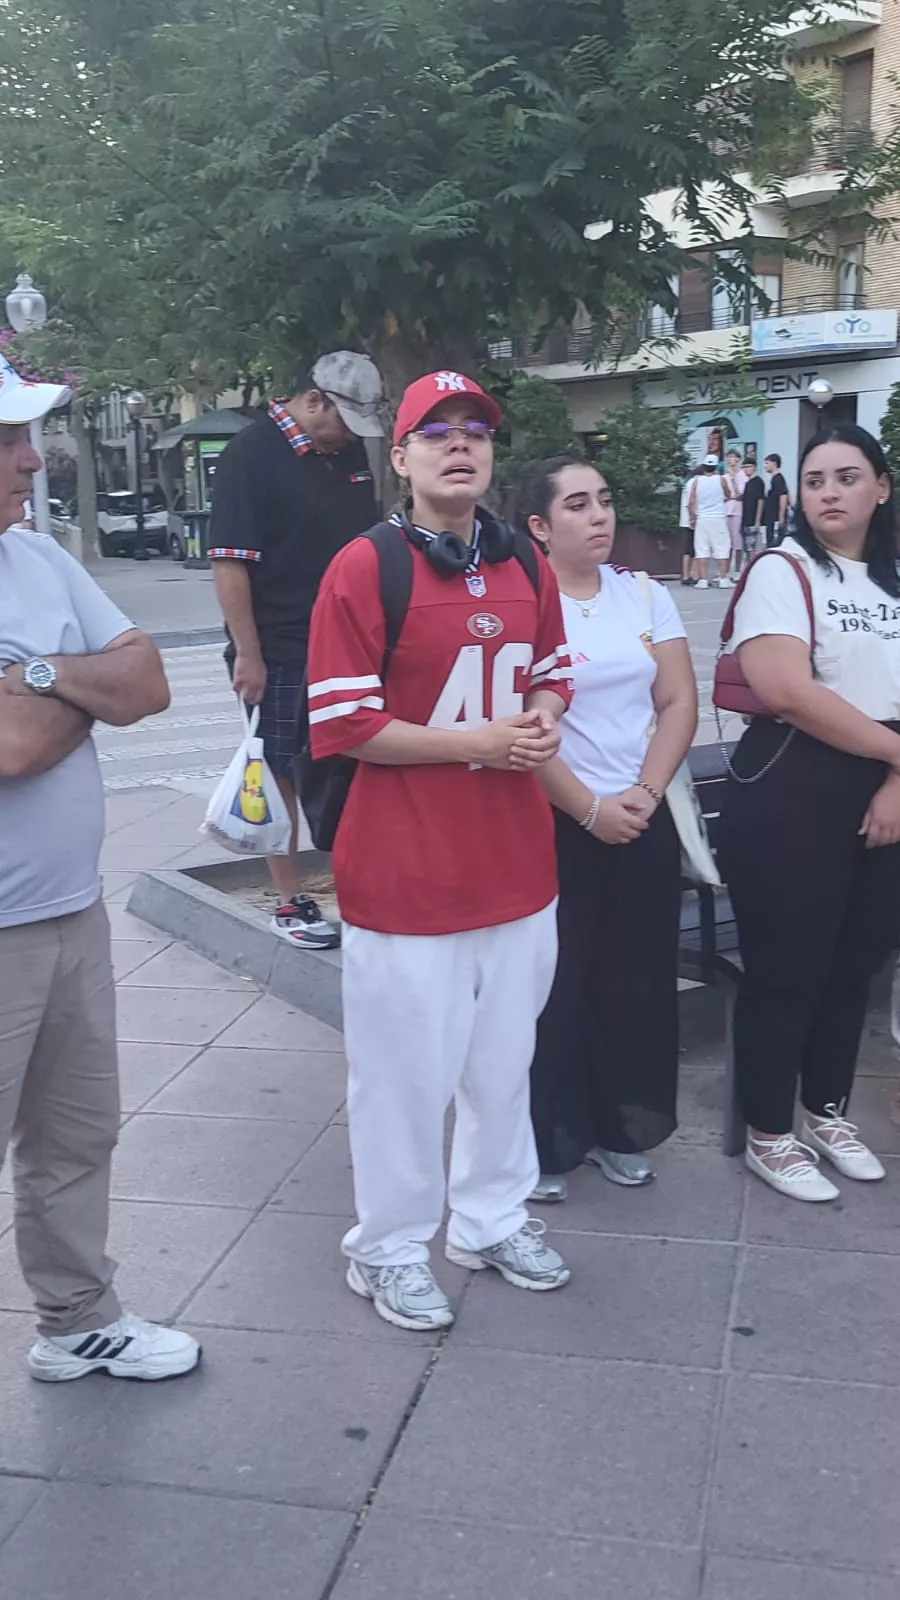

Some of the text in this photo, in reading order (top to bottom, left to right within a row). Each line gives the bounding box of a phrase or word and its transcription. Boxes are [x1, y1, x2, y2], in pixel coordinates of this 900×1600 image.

[434, 371, 467, 391] NY
[756, 371, 818, 393] DENT
[426, 643, 534, 771] 46
